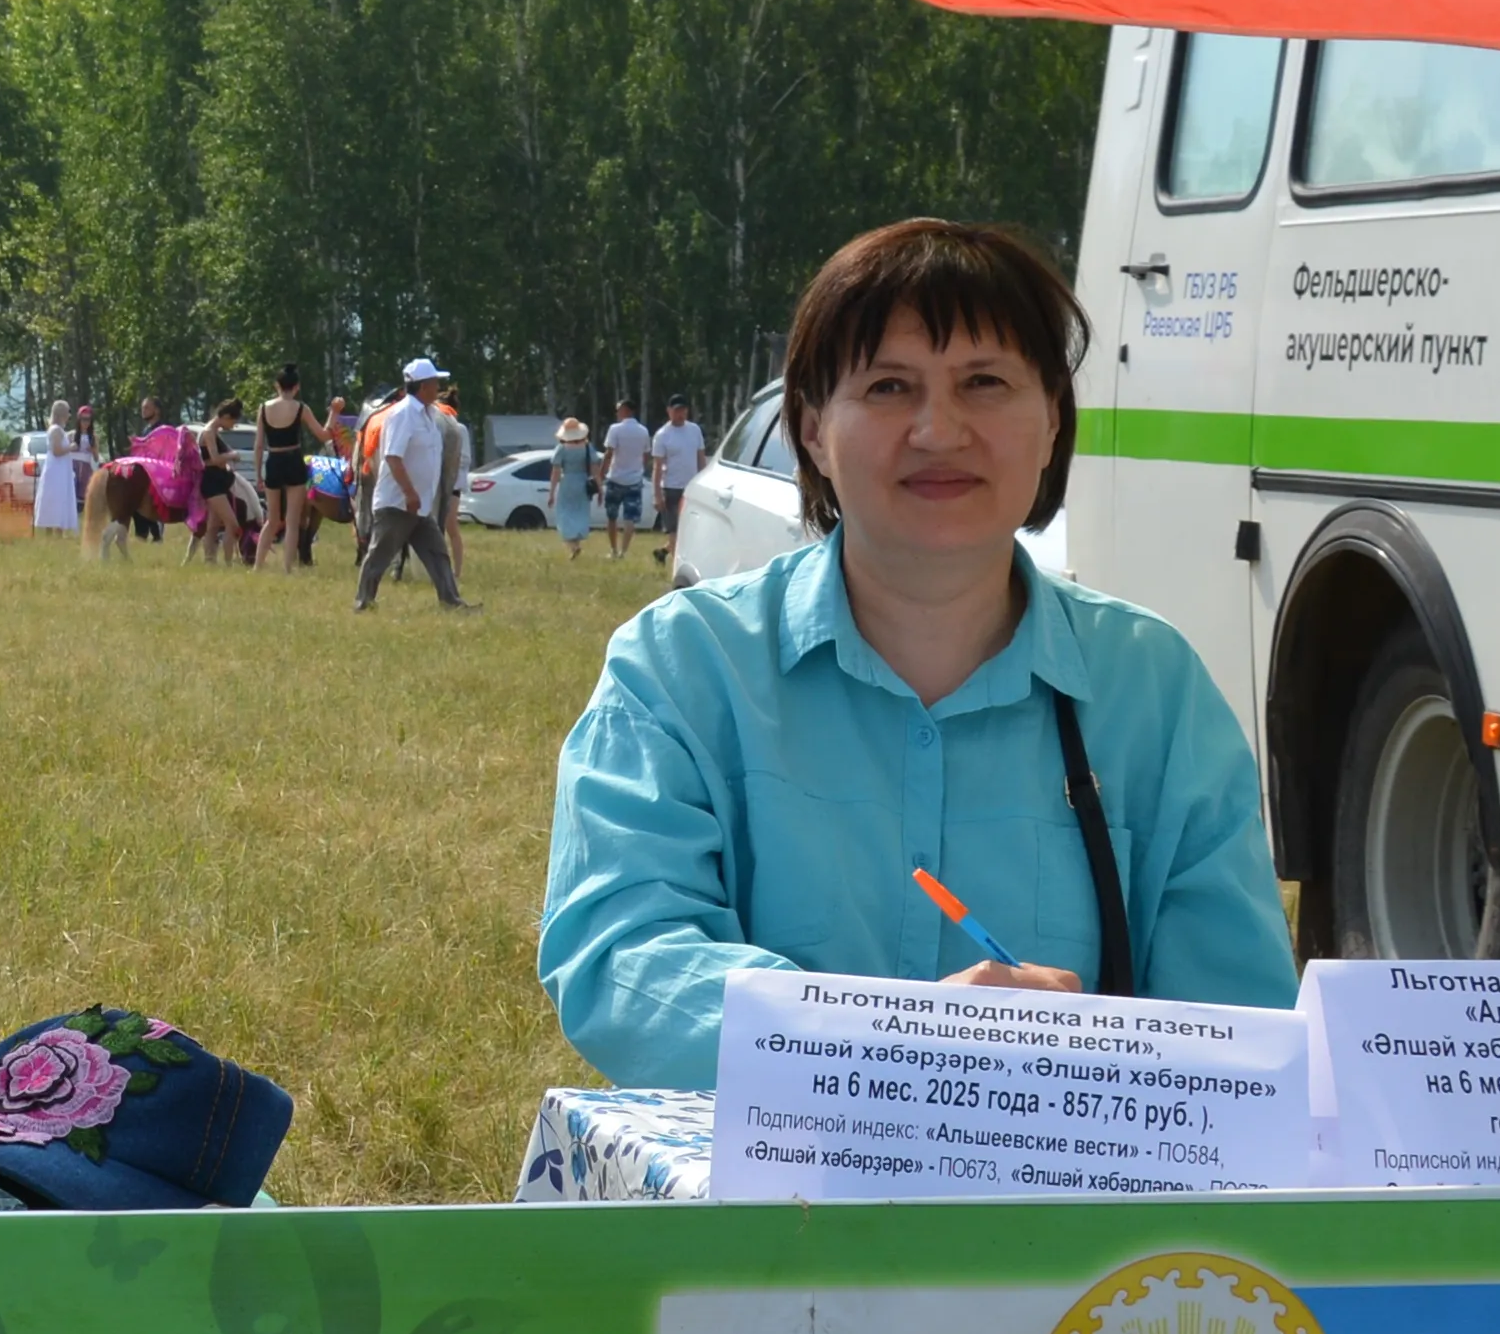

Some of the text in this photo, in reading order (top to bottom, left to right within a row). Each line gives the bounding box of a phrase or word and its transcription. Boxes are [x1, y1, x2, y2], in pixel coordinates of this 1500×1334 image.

[1183, 272, 1238, 299] ГБУЗ РБ
[1293, 261, 1449, 307] Фельдшерско-
[1143, 310, 1234, 344] Раевская ЦРБ
[1286, 322, 1489, 375] акушерский пункт
[801, 984, 1233, 1040] Льготная подписка на газеты
[872, 1015, 1162, 1060] «Альшеевские вести»,
[1361, 1032, 1456, 1058] «Әлшәй
[755, 1033, 853, 1059] «Әлшәй
[1021, 1057, 1120, 1084] «Әлшәй
[1129, 1069, 1277, 1099] хәбәрләре»
[1426, 1073, 1453, 1094] на
[1459, 1070, 1472, 1094] 6
[813, 1073, 839, 1096] на
[848, 1071, 860, 1097] 6
[868, 1079, 918, 1103] мес.
[926, 1079, 980, 1108] 2025
[988, 1090, 1039, 1117] года
[1063, 1091, 1137, 1124] 857,76
[1144, 1101, 1193, 1132] руб.
[747, 1105, 846, 1134] Подписной
[852, 1118, 919, 1140] индекс:
[926, 1122, 1068, 1153] «Альшеевские
[1074, 1138, 1139, 1158] вести»
[1158, 1141, 1224, 1169] ПО584,
[1374, 1148, 1471, 1172] Подписной
[745, 1140, 816, 1166] «Әлшәй
[939, 1156, 1001, 1184] ПО673,
[1011, 1164, 1083, 1190] «Әлшәй
